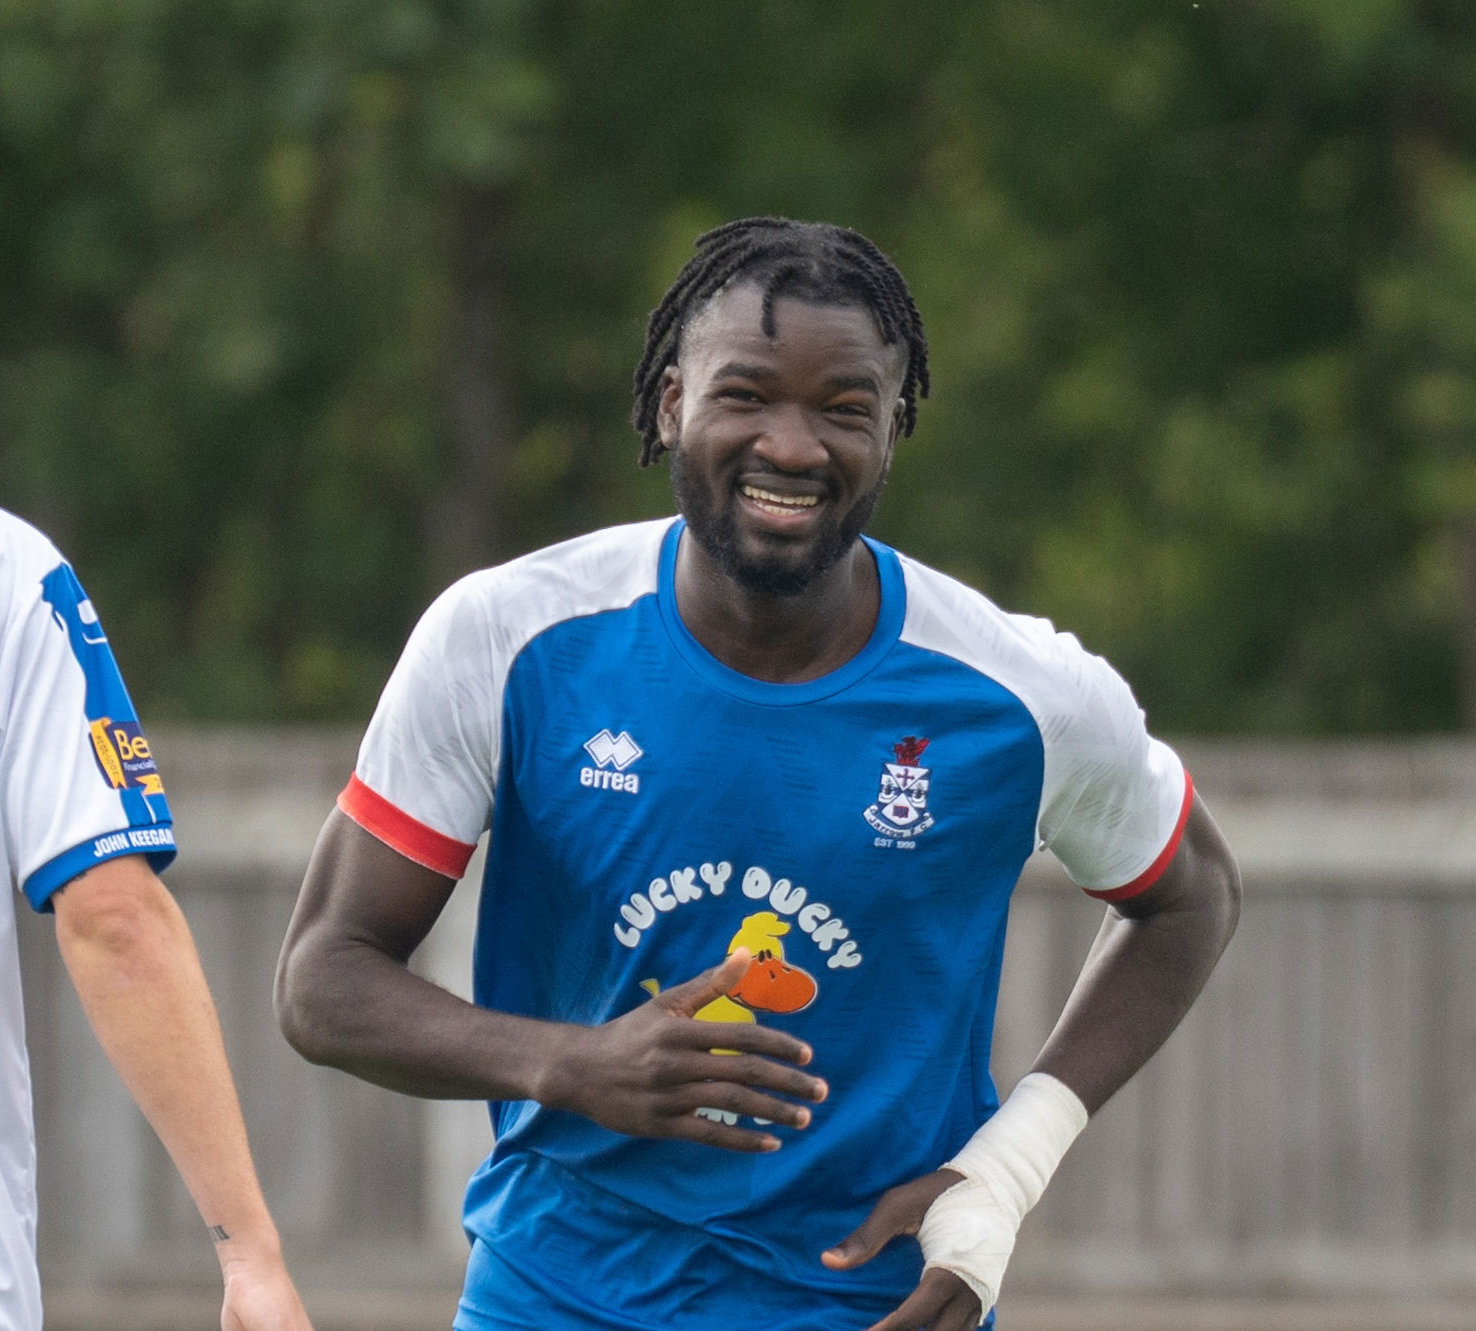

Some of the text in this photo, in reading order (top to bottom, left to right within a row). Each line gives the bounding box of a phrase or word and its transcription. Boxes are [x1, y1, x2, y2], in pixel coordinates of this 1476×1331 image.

[579, 766, 639, 794] errea
[93, 827, 175, 858] JOHN KEEGAN
[613, 860, 863, 970] LUCKY DUCKY
